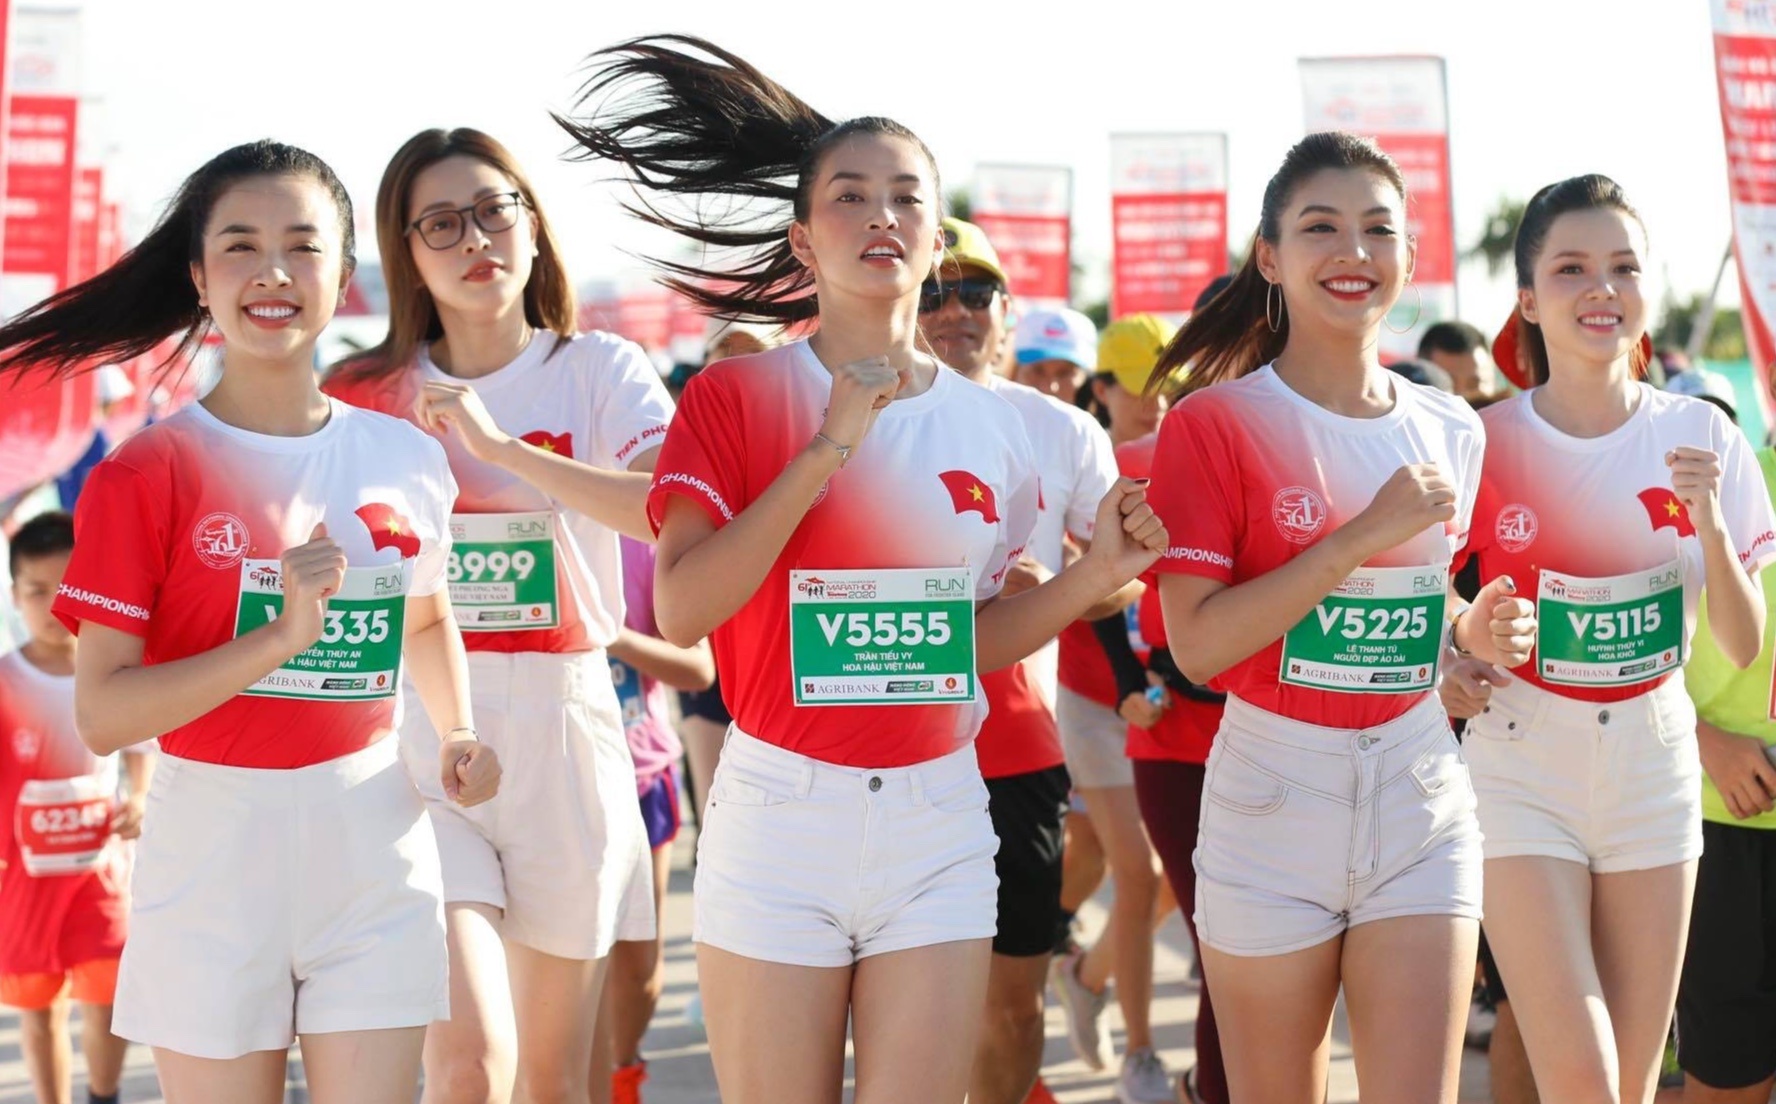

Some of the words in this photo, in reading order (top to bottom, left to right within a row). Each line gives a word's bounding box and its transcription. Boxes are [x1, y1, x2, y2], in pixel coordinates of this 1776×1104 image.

[507, 521, 547, 533] RUN
[447, 550, 535, 581] 8999
[374, 575, 402, 590] RUN
[925, 578, 965, 591] RUN
[1413, 575, 1442, 588] RUN
[848, 591, 877, 599] 2020
[1347, 587, 1374, 595] 2020
[264, 604, 389, 644] 335
[1316, 604, 1427, 639] V5225
[1567, 602, 1661, 641] V5115
[815, 611, 951, 647] V5555
[1636, 639, 1644, 647] VI
[349, 650, 362, 658] AN
[1358, 645, 1386, 654] THANH
[854, 651, 878, 661] TRẦN
[901, 652, 913, 660] VY
[1380, 654, 1392, 663] ÁO
[1598, 652, 1616, 661] HOA
[318, 658, 337, 669] VIỆT
[338, 660, 358, 669] NAM
[842, 663, 862, 672] HOA
[863, 662, 882, 673] HẬU
[884, 662, 903, 673] VIỆT
[905, 662, 925, 671] NAM
[1303, 668, 1365, 684] AGRIBANK
[1557, 667, 1612, 678] AGRIBANK
[258, 676, 316, 689] GRIBANK
[817, 683, 880, 694] AGRIBANK
